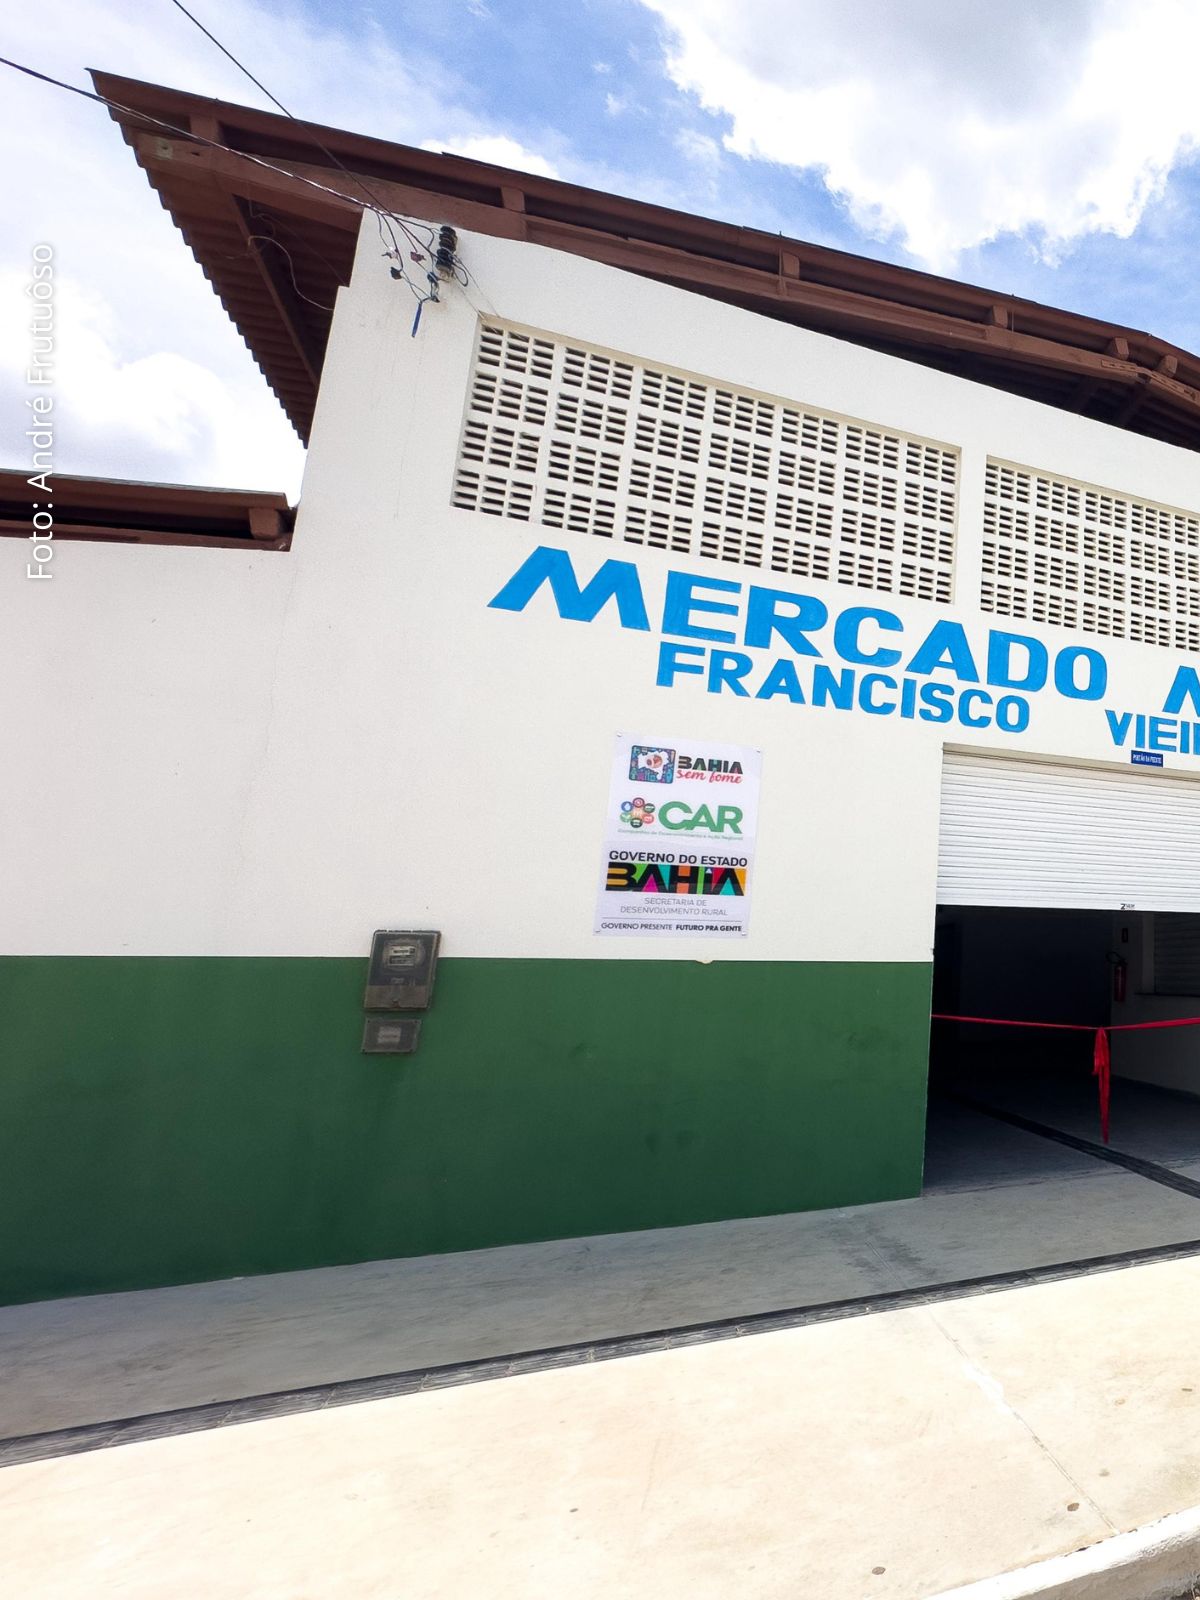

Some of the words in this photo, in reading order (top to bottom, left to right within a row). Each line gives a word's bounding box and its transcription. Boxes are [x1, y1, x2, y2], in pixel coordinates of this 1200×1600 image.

[486, 545, 1109, 702] MERCADO
[655, 640, 1031, 734] FRANCISCO
[678, 755, 744, 775] BAHIA
[676, 769, 707, 781] sem
[708, 771, 744, 785] fome
[658, 800, 744, 835] CAR
[608, 850, 675, 864] GOVERNO
[678, 854, 698, 865] DO
[701, 855, 748, 867] ESTADO
[605, 861, 747, 897] BAHIA
[620, 906, 700, 917] DESENVOLVIMENTO
[701, 908, 729, 917] RURAL
[644, 897, 695, 907] SECRETARIA
[696, 899, 707, 908] DE
[601, 922, 639, 931] GOVERNO
[640, 923, 673, 932] PRESENTE
[675, 924, 704, 932] FUTURO
[719, 925, 742, 933] GENTE
